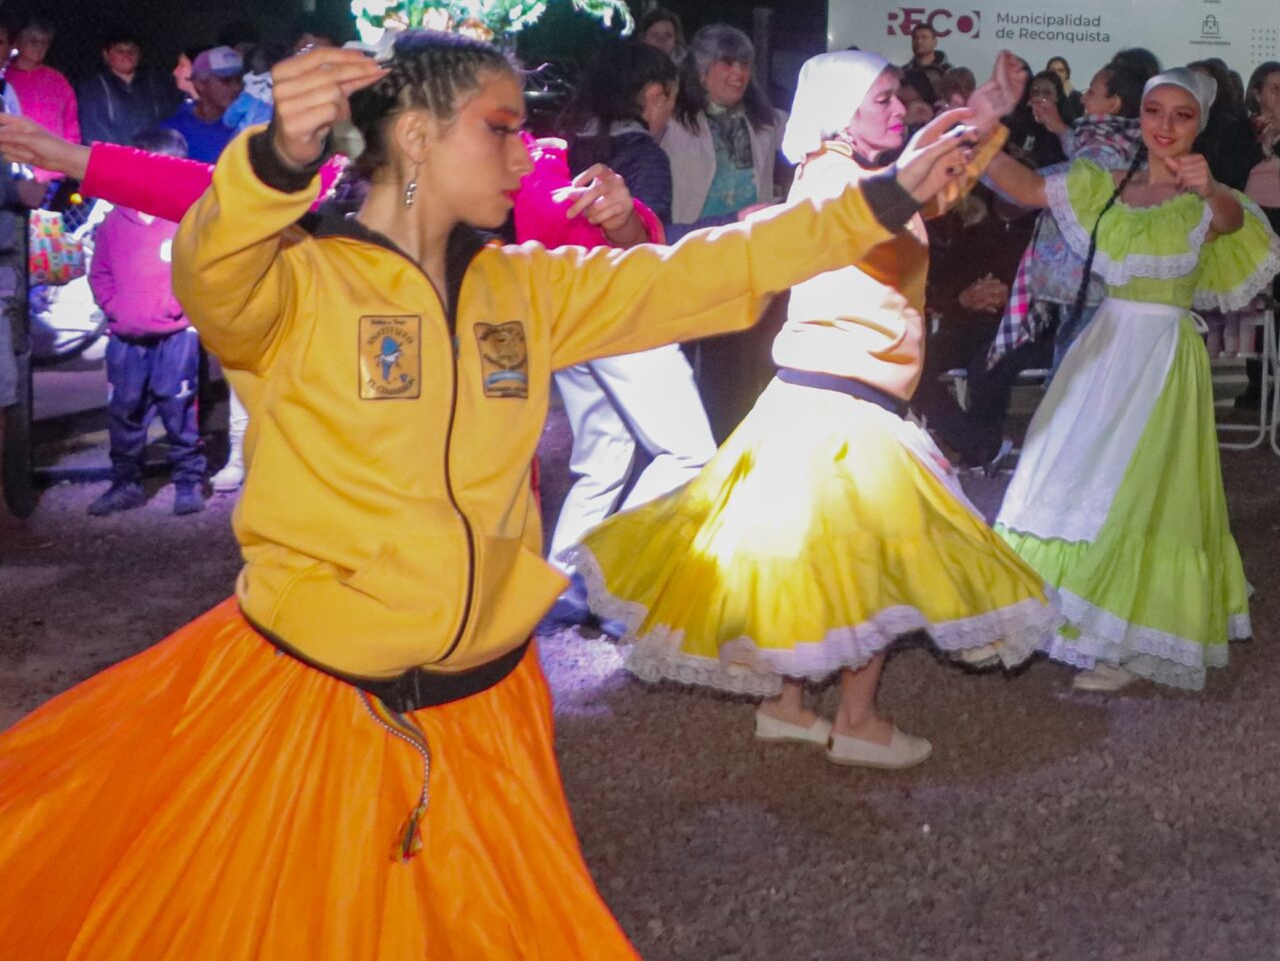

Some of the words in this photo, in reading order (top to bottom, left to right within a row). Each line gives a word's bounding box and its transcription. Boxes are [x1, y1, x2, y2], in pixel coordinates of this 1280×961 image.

[996, 12, 1101, 28] Municipalidad
[995, 27, 1014, 39] de
[1019, 28, 1111, 43] Reconquista
